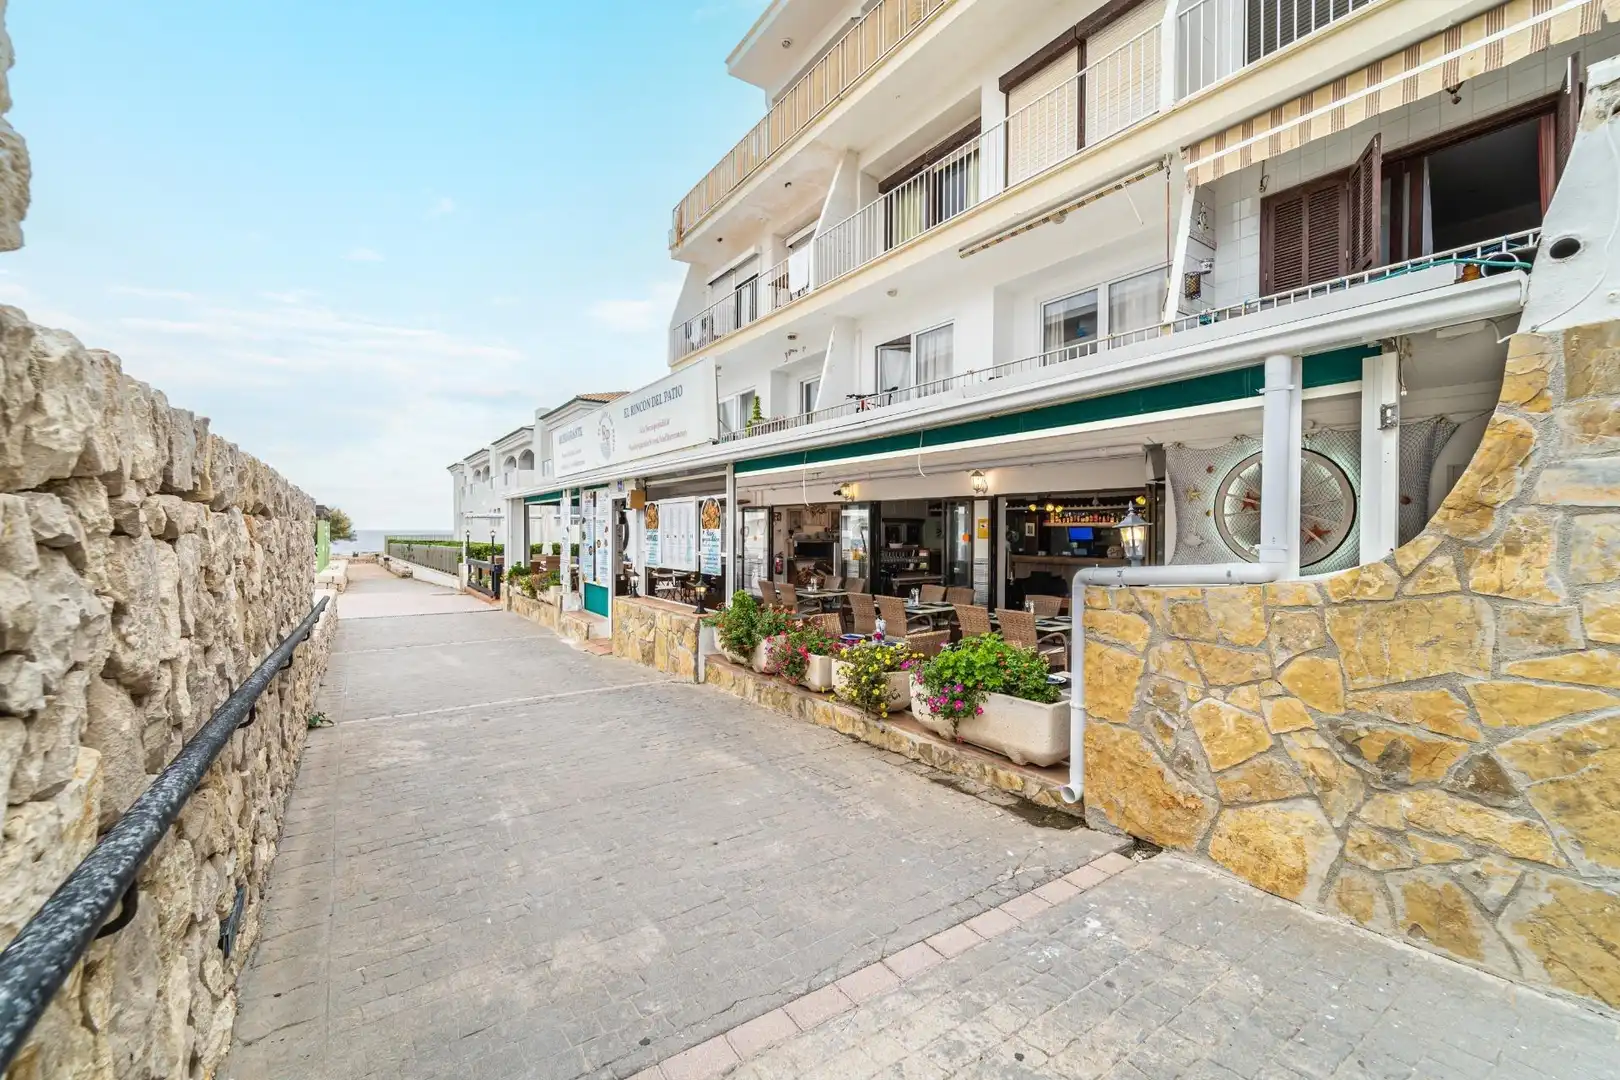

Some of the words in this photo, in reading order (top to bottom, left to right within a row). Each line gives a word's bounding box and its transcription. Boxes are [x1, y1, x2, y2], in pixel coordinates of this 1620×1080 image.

[623, 407, 630, 418] EL
[651, 393, 662, 408] DEL
[663, 384, 683, 403] PATIO
